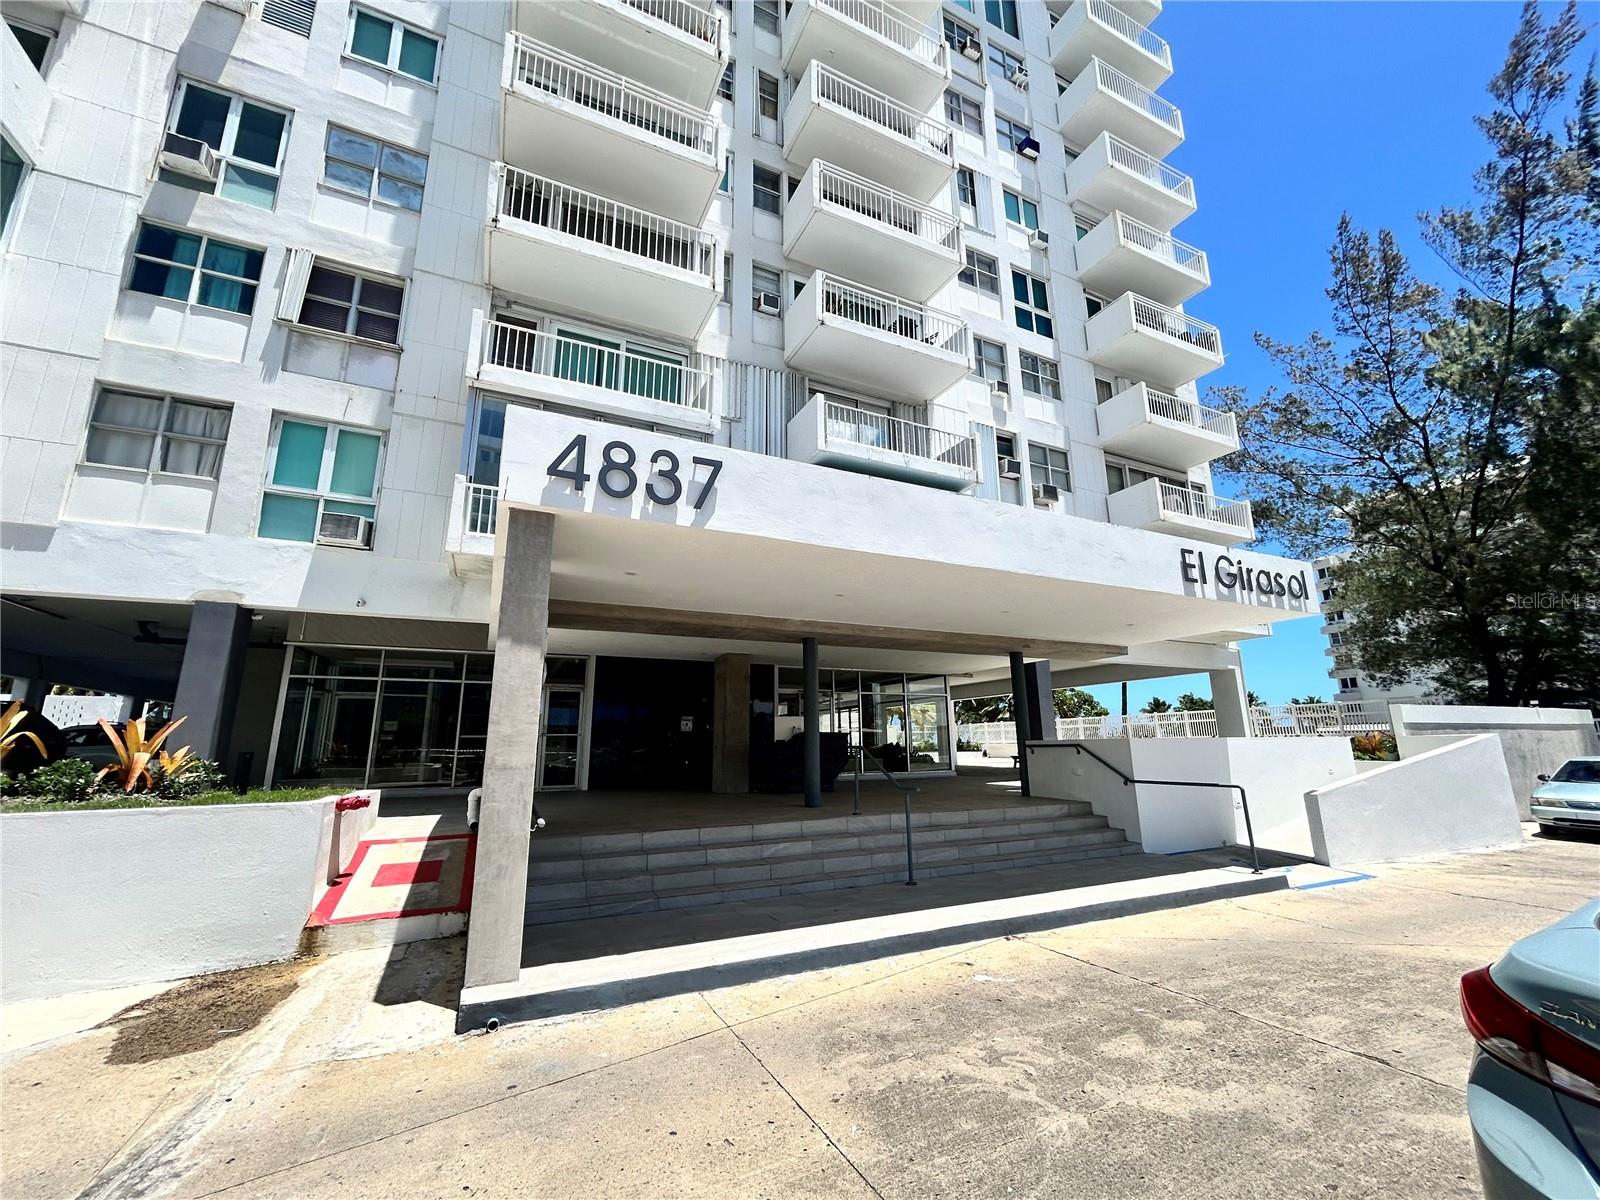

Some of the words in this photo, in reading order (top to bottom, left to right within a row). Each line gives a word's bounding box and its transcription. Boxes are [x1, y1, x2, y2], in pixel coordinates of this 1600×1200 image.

[547, 434, 723, 510] 4837
[1180, 548, 1207, 584] El
[1214, 555, 1309, 600] Girasol
